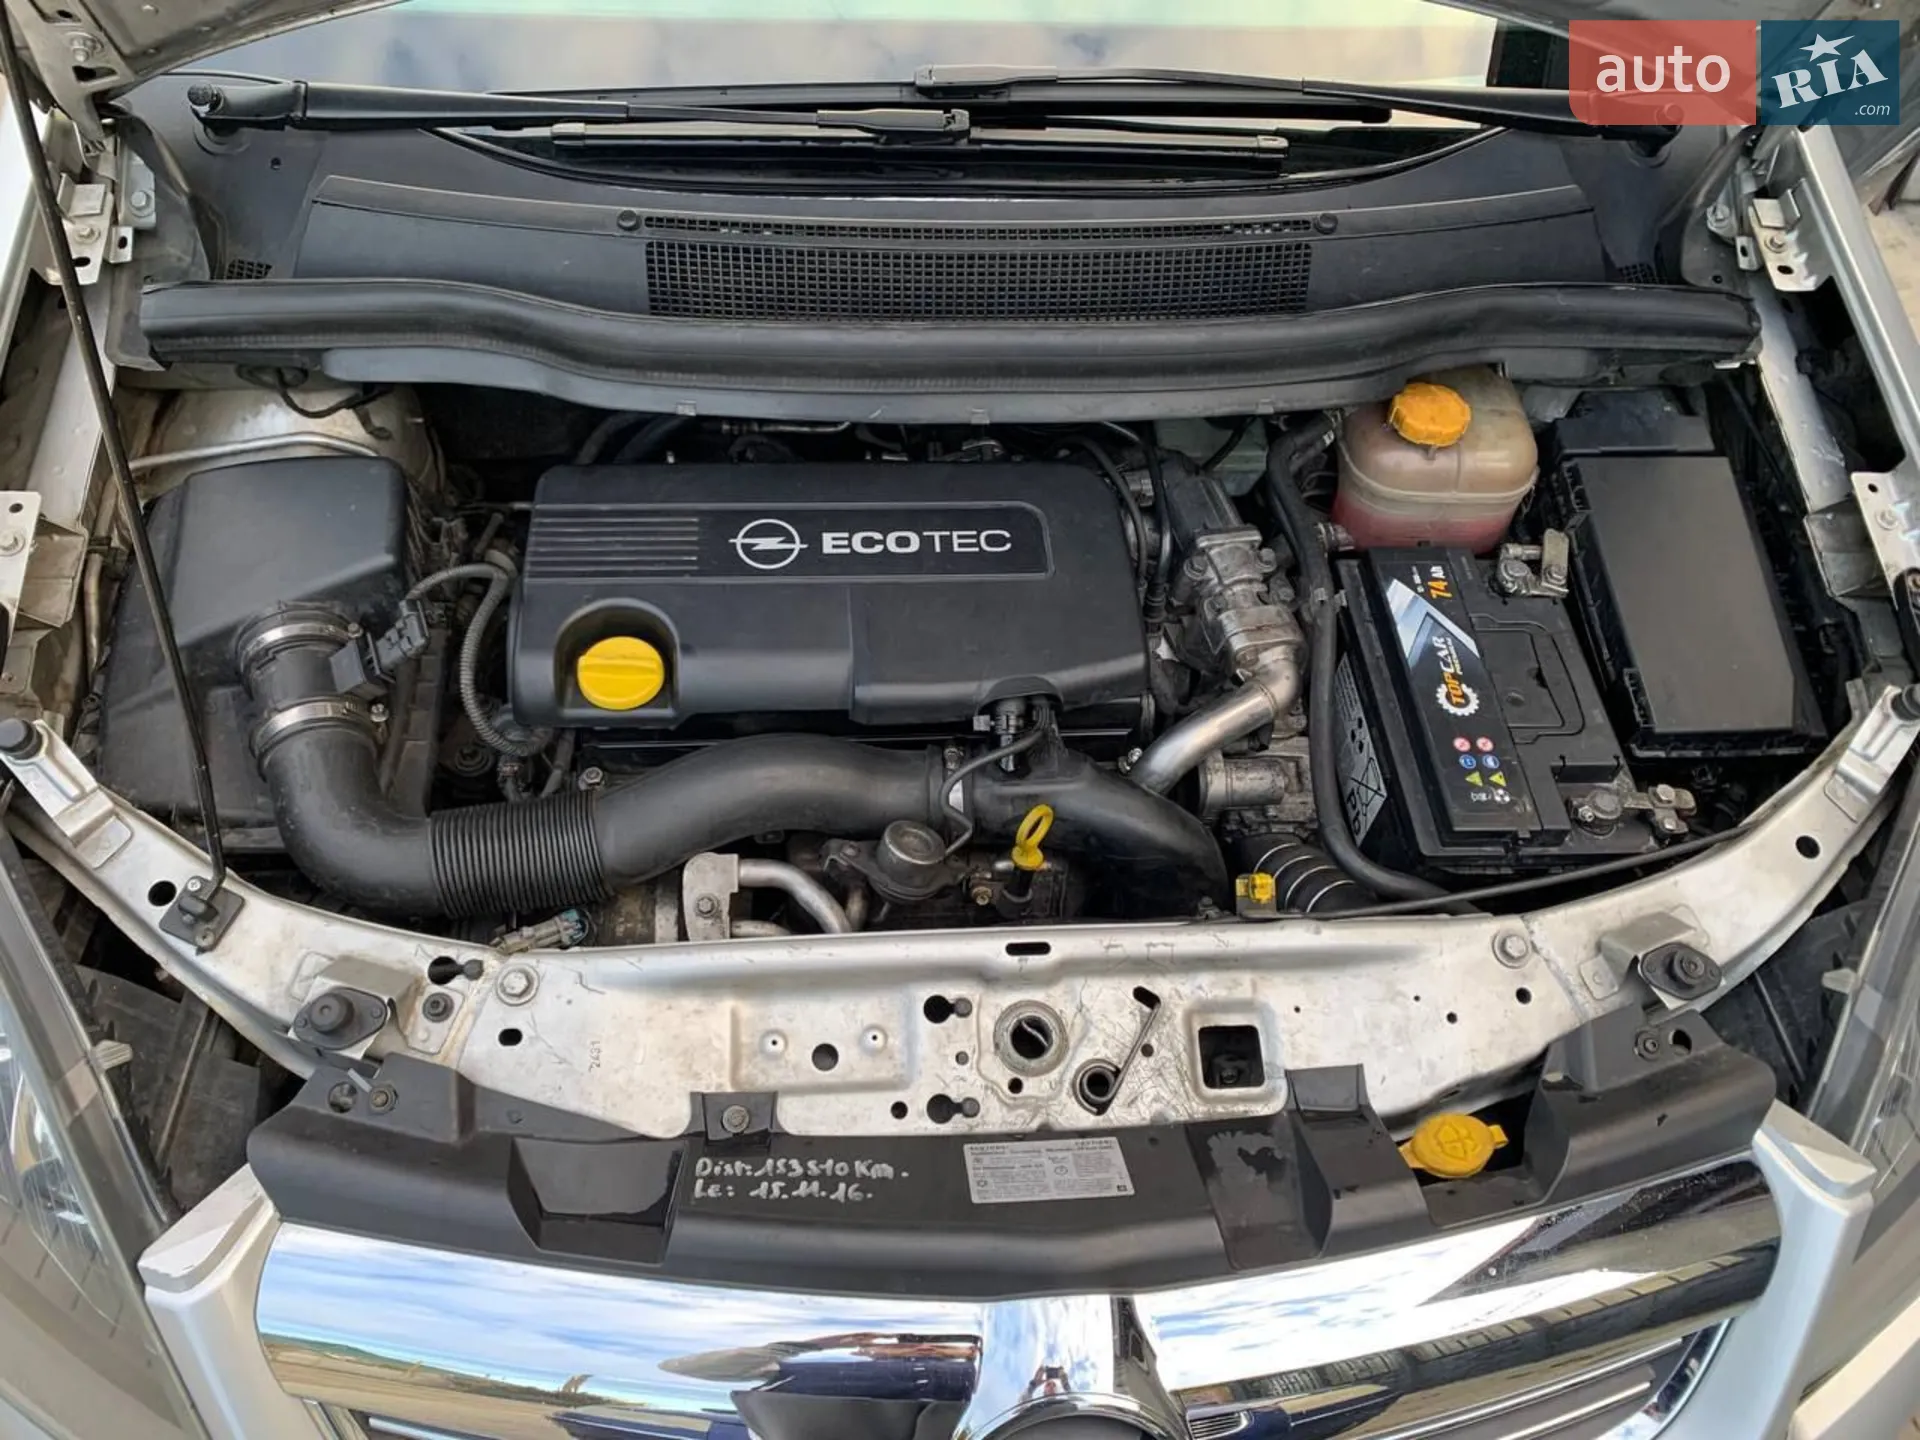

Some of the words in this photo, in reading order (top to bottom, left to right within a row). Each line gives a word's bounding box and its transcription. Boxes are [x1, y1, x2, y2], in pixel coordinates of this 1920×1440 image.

[821, 530, 1012, 554] ECOTEC
[1427, 580, 1453, 599] 74
[1432, 635, 1466, 705] TOPCAR
